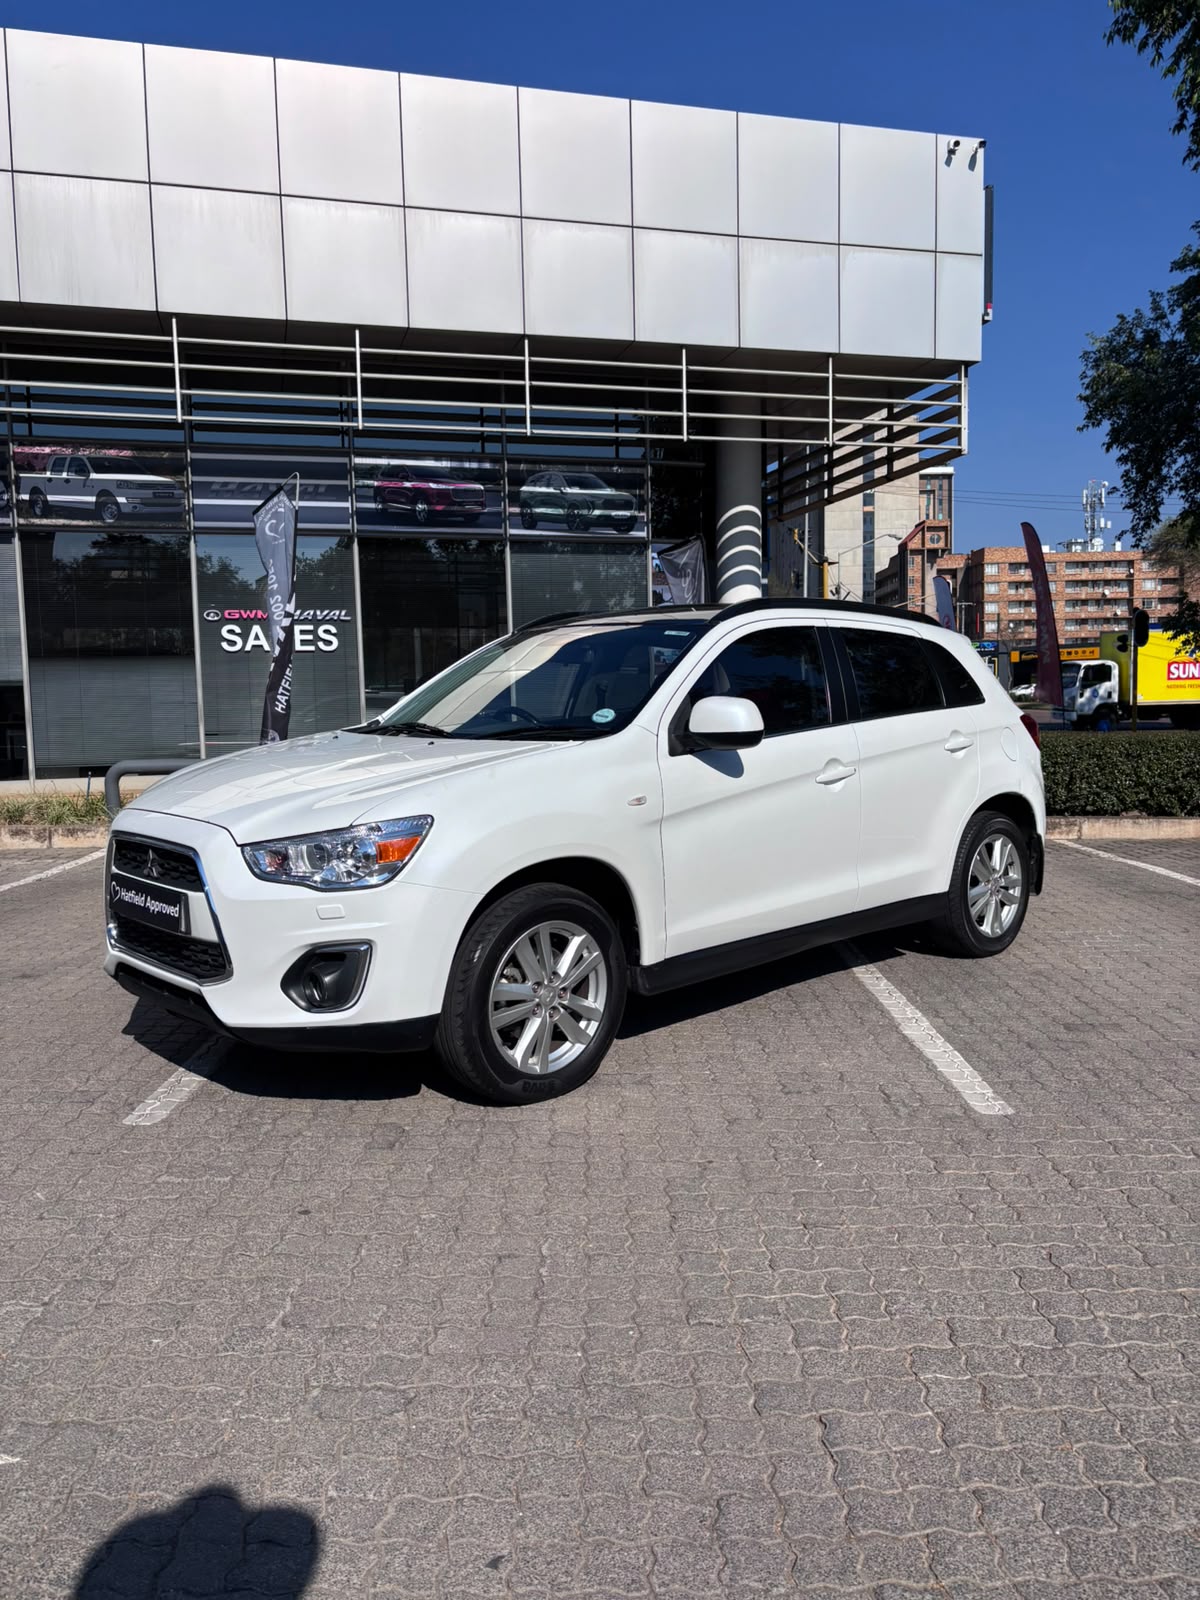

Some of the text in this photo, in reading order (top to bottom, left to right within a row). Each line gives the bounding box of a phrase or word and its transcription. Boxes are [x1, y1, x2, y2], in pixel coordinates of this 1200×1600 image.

[220, 624, 340, 652] SAES
[121, 888, 179, 917] Hatfield Approved
